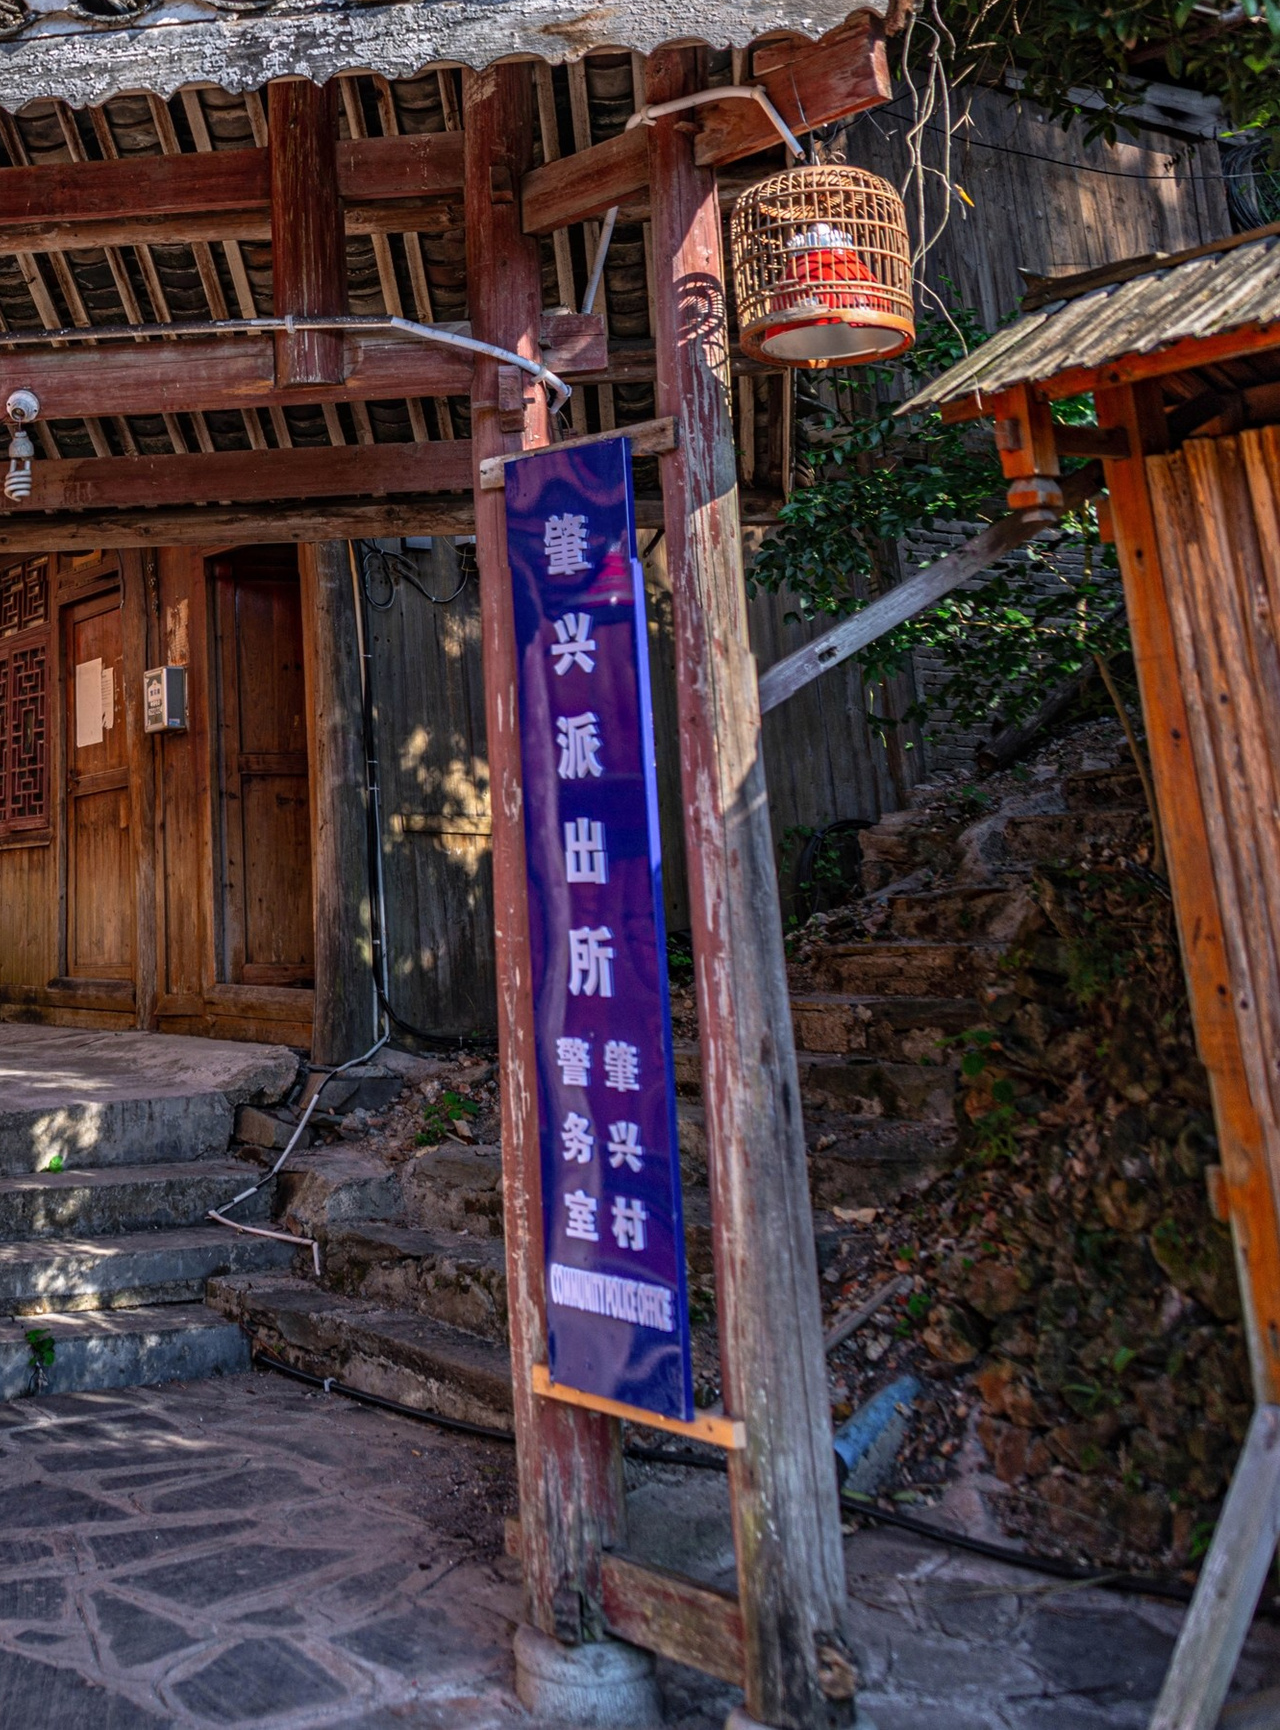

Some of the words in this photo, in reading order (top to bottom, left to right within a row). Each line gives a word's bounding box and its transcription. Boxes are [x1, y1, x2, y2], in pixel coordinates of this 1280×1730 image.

[543, 512, 615, 998] 肇兴派出所
[556, 1036, 599, 1242] 警务室
[603, 1039, 647, 1251] 肇兴村
[605, 1275, 639, 1324] POLICE
[637, 1280, 673, 1333] OFFICE
